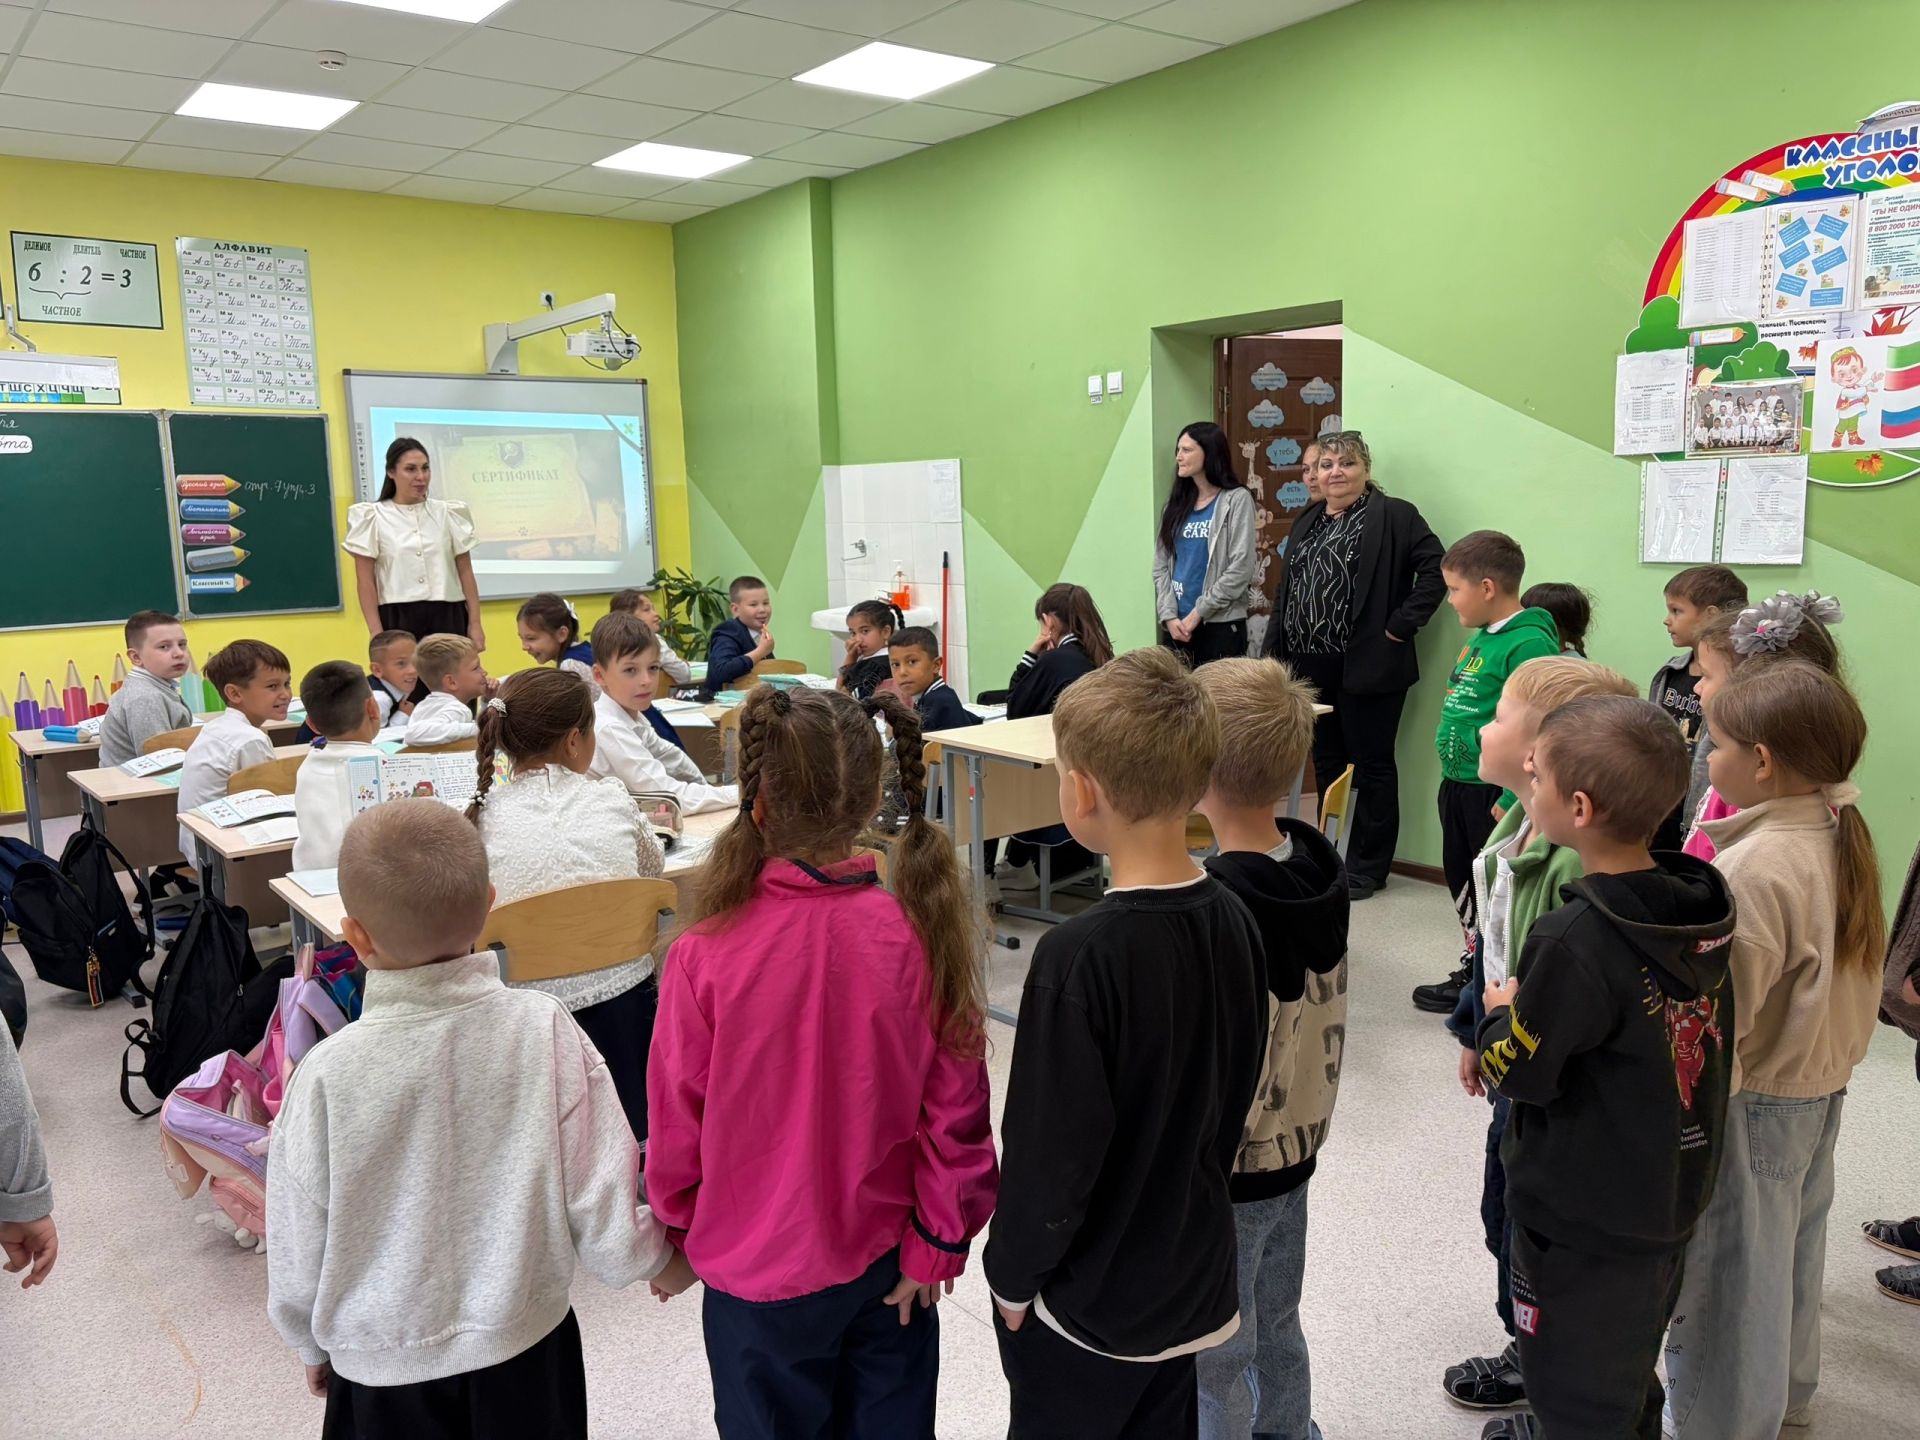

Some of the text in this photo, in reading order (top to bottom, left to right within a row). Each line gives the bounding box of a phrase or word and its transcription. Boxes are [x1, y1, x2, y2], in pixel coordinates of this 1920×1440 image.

[1786, 126, 1919, 166] КЛАССНЫ
[1825, 153, 1920, 187] УГОЛО
[1887, 206, 1898, 214] НЕ
[1888, 222, 1906, 231] 2000
[24, 240, 147, 260] ДЕЛИМОЕ ДЕЛИТЕЛЬ ЧАСТНОЕ
[213, 243, 273, 255] АЛФАВИТ
[28, 262, 42, 282] 6
[79, 265, 92, 285] 2
[119, 268, 132, 288] 3
[41, 305, 82, 317] ЧАСТНОЕ
[472, 469, 560, 485] СЕРТИФИКАТ
